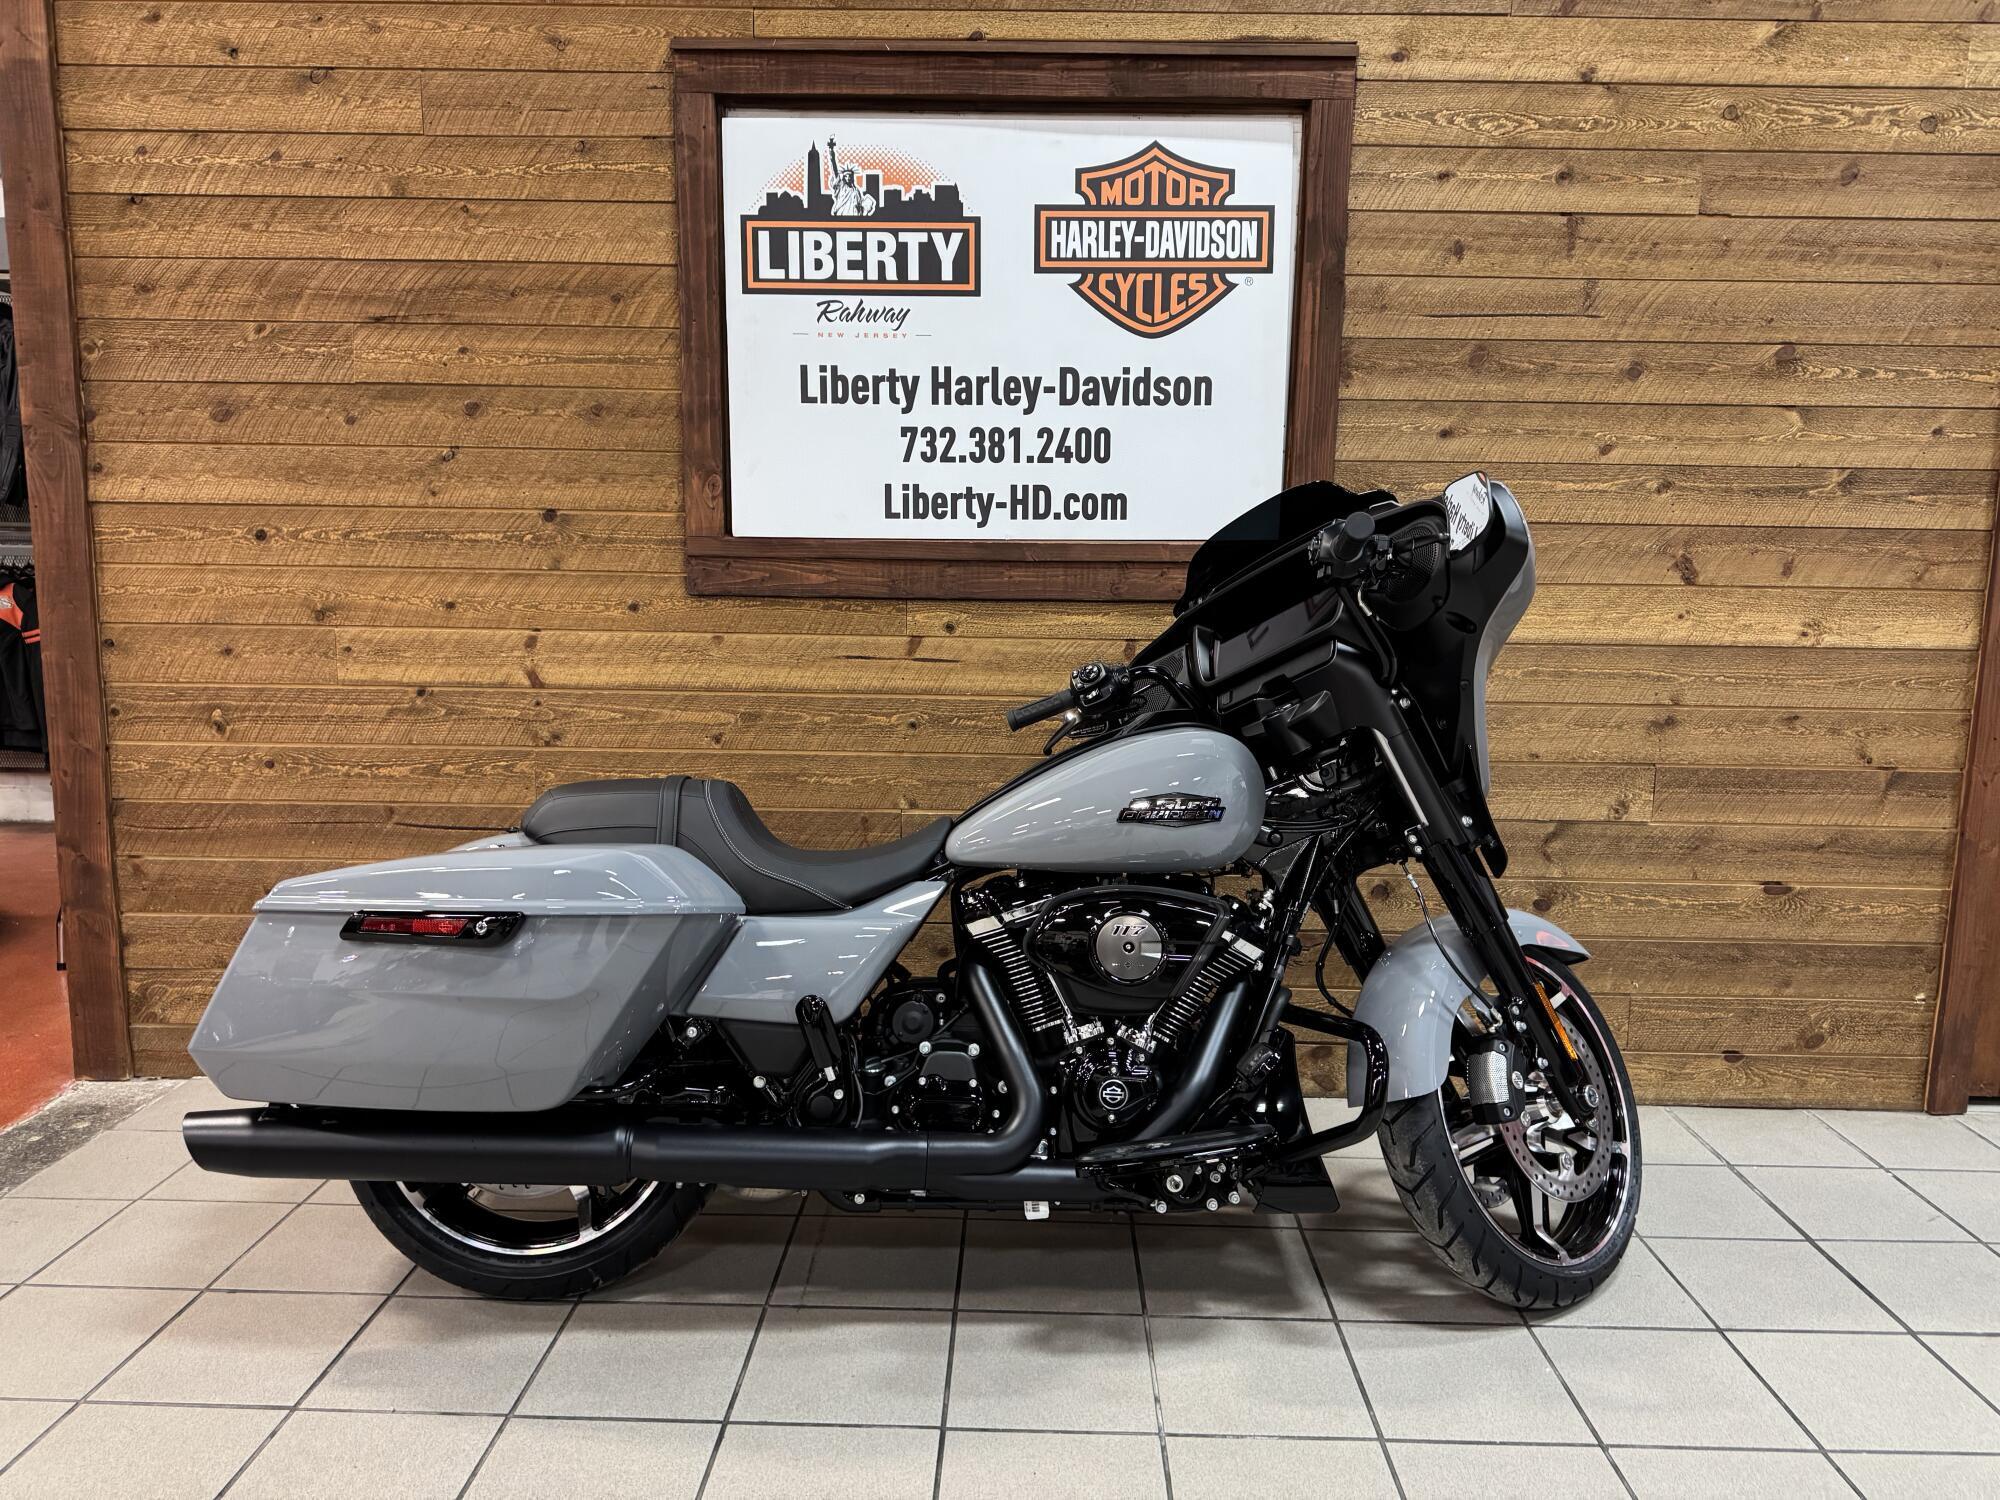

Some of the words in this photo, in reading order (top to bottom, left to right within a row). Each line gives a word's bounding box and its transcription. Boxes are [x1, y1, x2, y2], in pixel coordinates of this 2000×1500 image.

[1100, 160, 1210, 206] MOTOR
[757, 230, 964, 282] LIBERTY
[1050, 219, 1258, 260] HARLEY-DAVIDSON
[816, 298, 911, 332] Rahway
[1098, 273, 1208, 323] CYCLES
[800, 364, 920, 415] Liberty
[931, 365, 1213, 416] Harley-Davidson
[900, 425, 1112, 464] 732.381.2400
[884, 483, 1128, 529] Liberty-HD.com
[1111, 925, 1148, 936] 117
